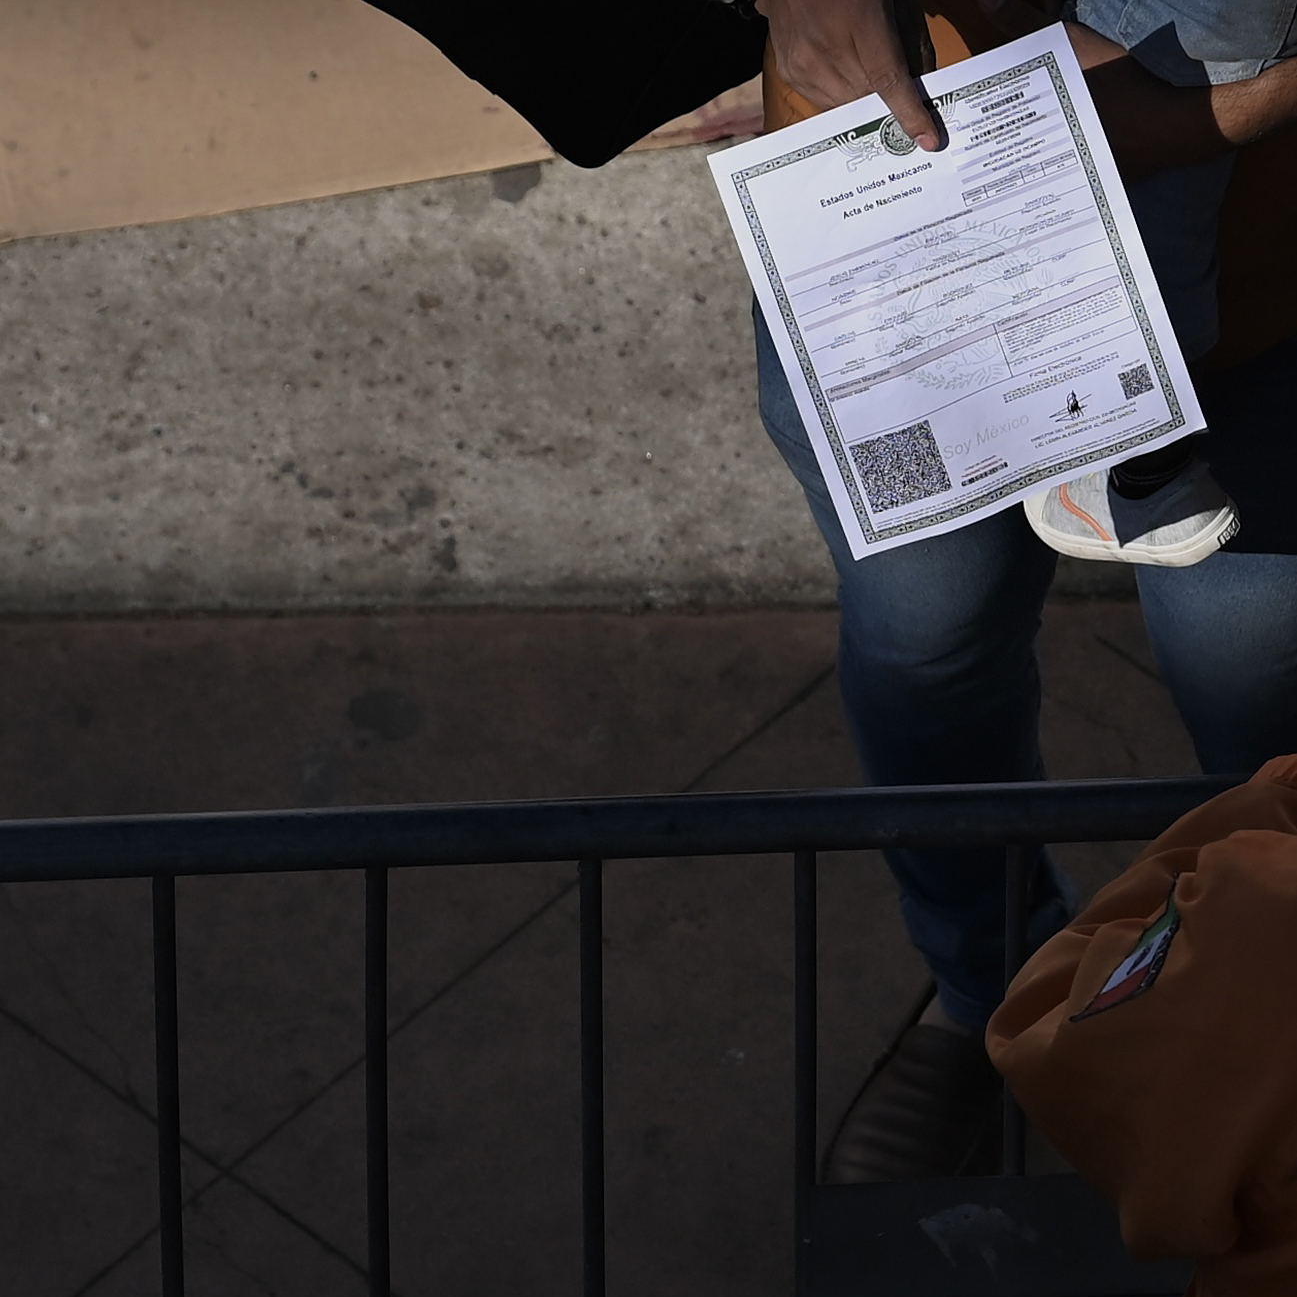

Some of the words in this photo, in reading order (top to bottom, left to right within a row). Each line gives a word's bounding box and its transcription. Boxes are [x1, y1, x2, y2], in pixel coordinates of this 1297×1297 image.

[820, 190, 854, 208] Estados
[856, 178, 886, 195] Unidos
[888, 161, 933, 183] Mexicanos
[842, 206, 862, 219] Acta
[863, 202, 874, 212] de
[875, 185, 923, 207] Nacimiento
[942, 440, 974, 461] Soy
[975, 413, 1030, 445] México
